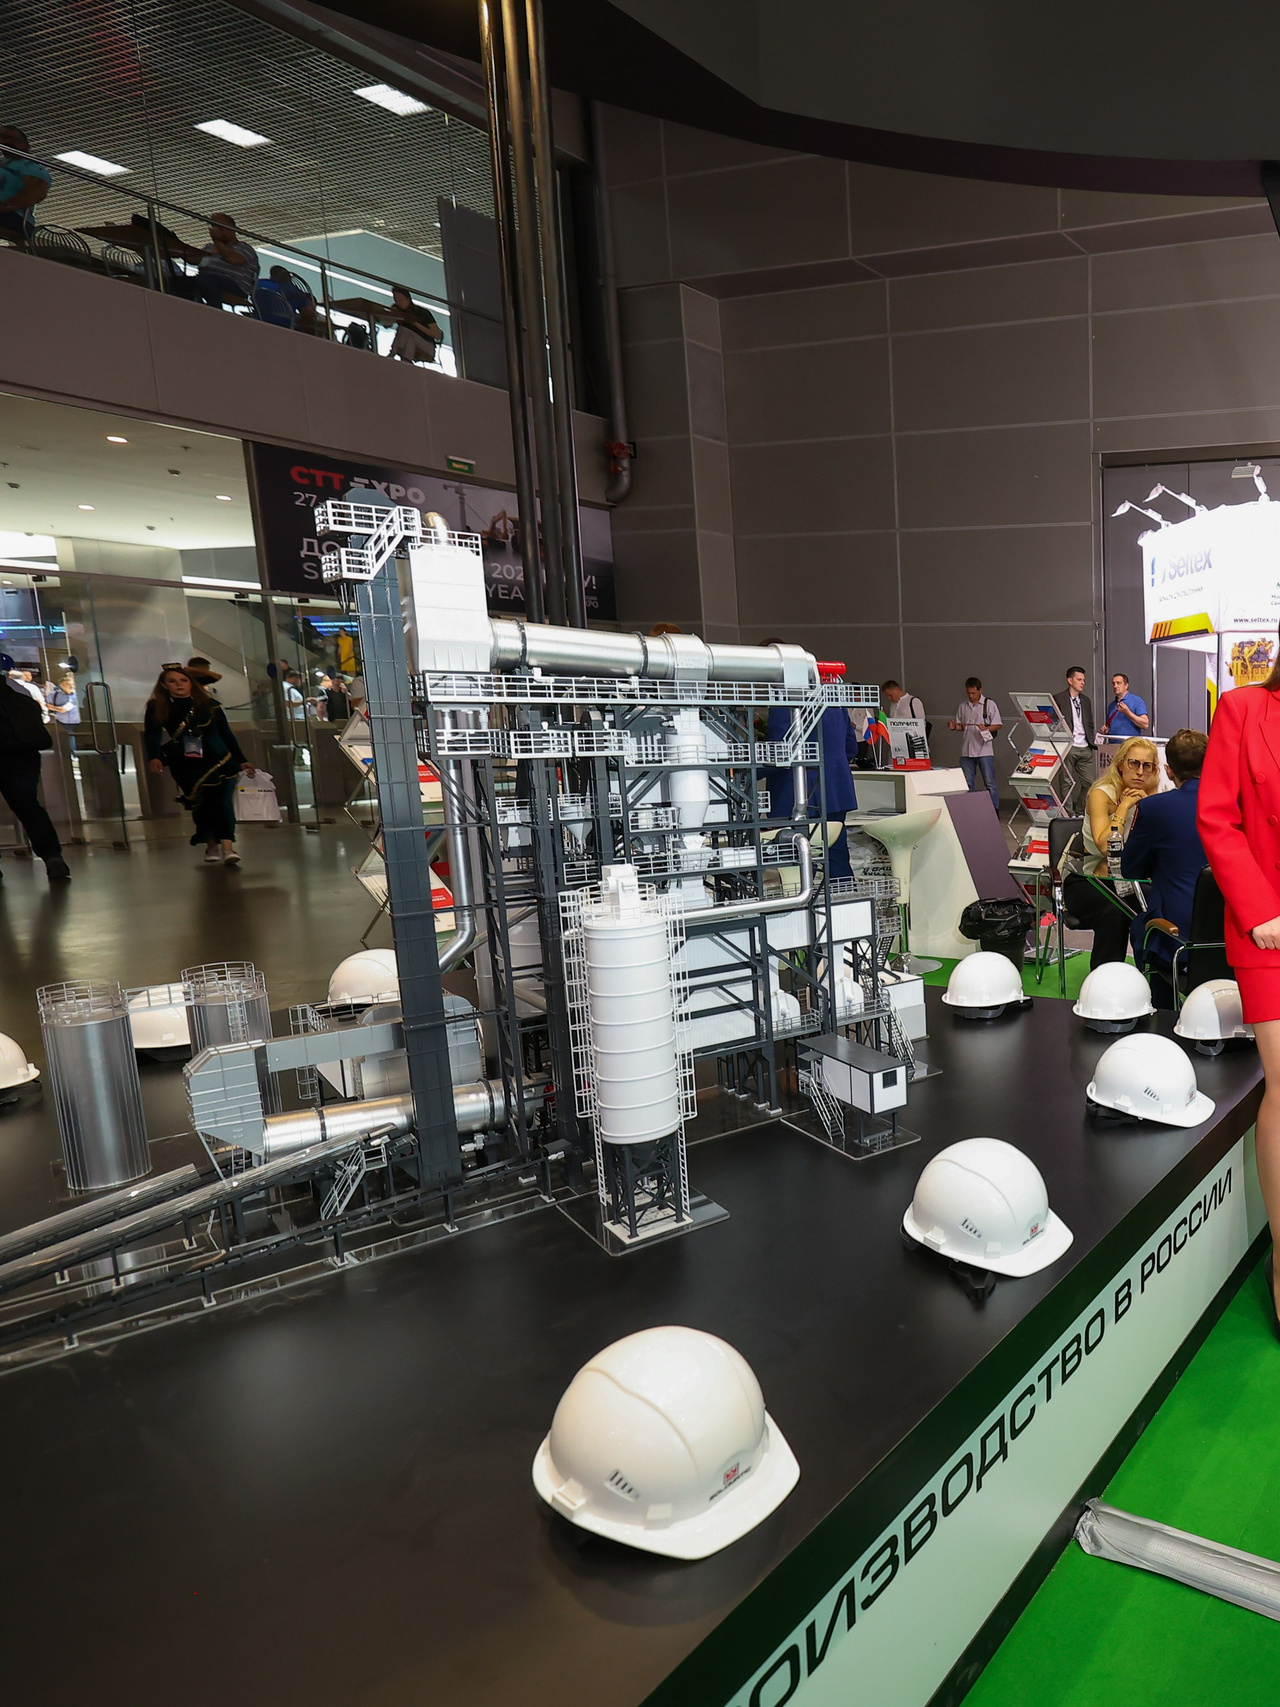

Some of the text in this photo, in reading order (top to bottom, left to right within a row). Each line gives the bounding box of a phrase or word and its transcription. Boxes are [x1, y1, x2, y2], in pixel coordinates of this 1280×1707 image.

[290, 465, 345, 490] CTT
[491, 562, 525, 581] 202
[486, 584, 526, 601] YEA
[750, 1166, 1233, 1707] ОИЗВОДСТВО В РОССИИ
